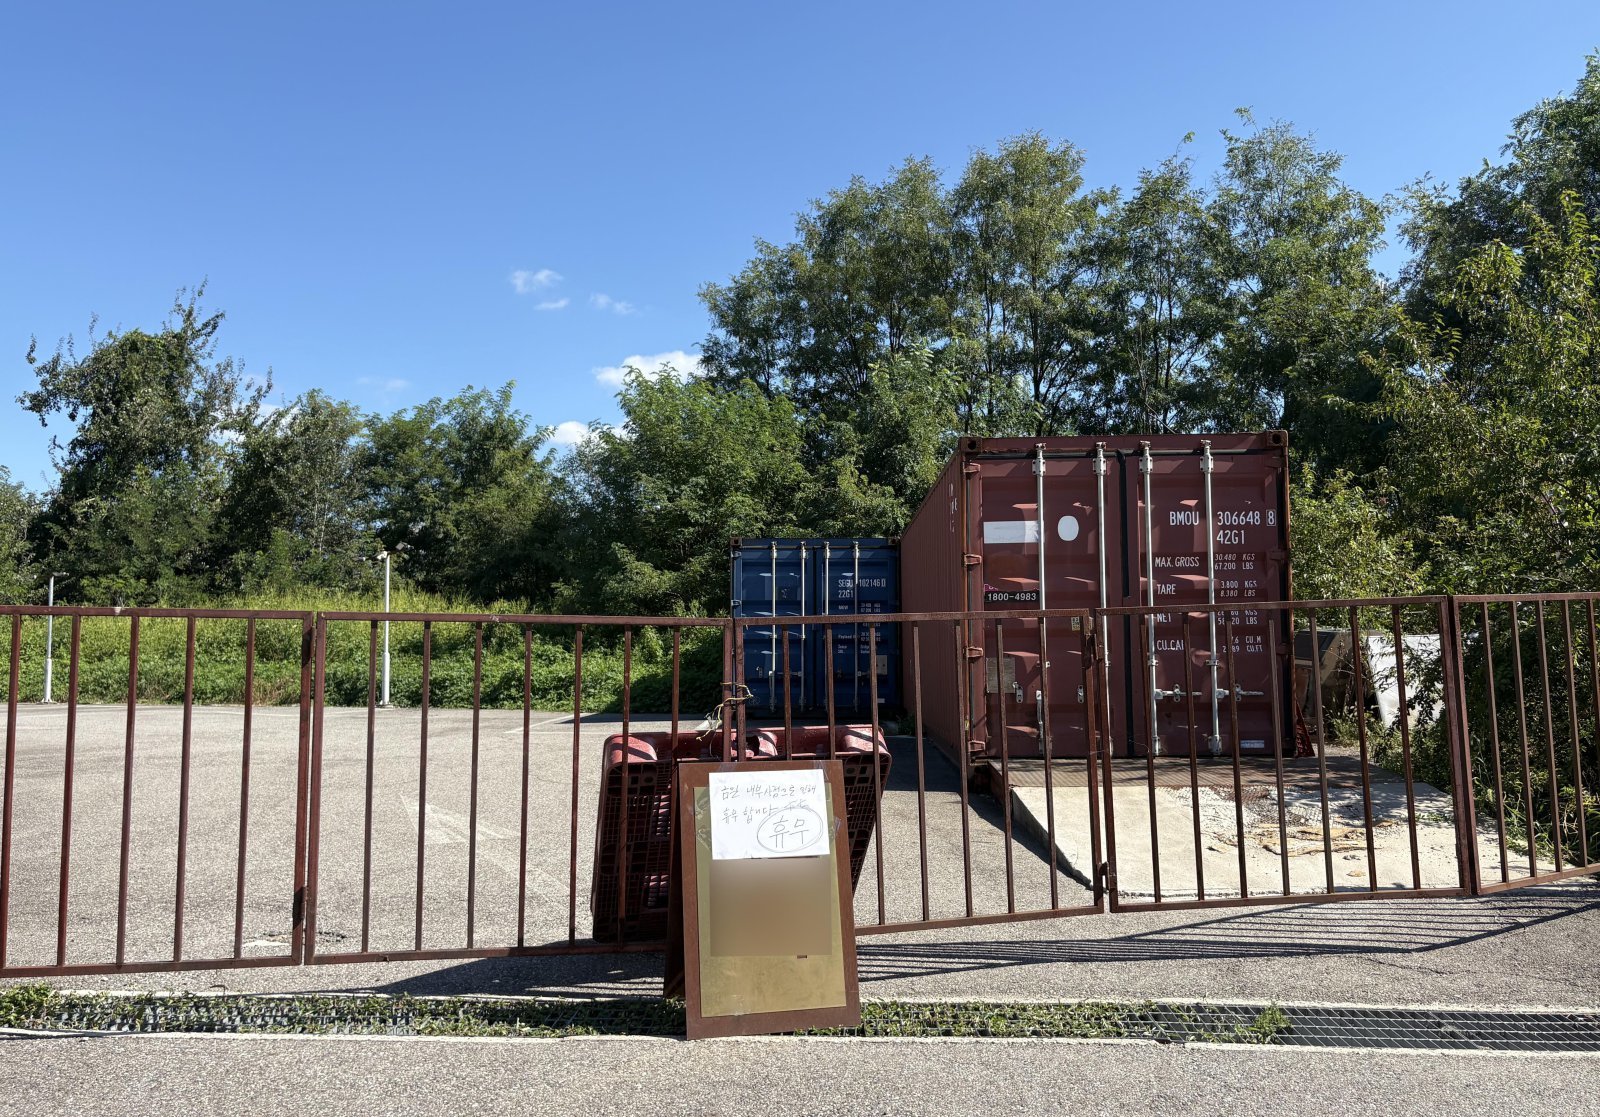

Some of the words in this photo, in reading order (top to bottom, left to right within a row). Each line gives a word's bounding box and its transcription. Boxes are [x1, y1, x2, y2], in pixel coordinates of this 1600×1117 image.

[1169, 511, 1200, 526] BMOU
[1217, 510, 1261, 526] 306648
[1267, 510, 1276, 526] 8
[1216, 530, 1245, 545] 42G1
[1242, 553, 1255, 561] KGS
[1175, 556, 1200, 568] GROSS
[1214, 562, 1236, 570] 67.200
[1242, 562, 1254, 570] LBS
[838, 579, 854, 588] SEGU
[1244, 580, 1257, 588] KGS
[1156, 583, 1177, 595] TARE
[1244, 589, 1256, 597] LBS
[838, 590, 854, 598] 22G1
[987, 592, 1037, 601] 1800-4983
[1245, 616, 1258, 625] LBS
[721, 806, 738, 825] 휴무
[768, 815, 810, 849] 휴무
